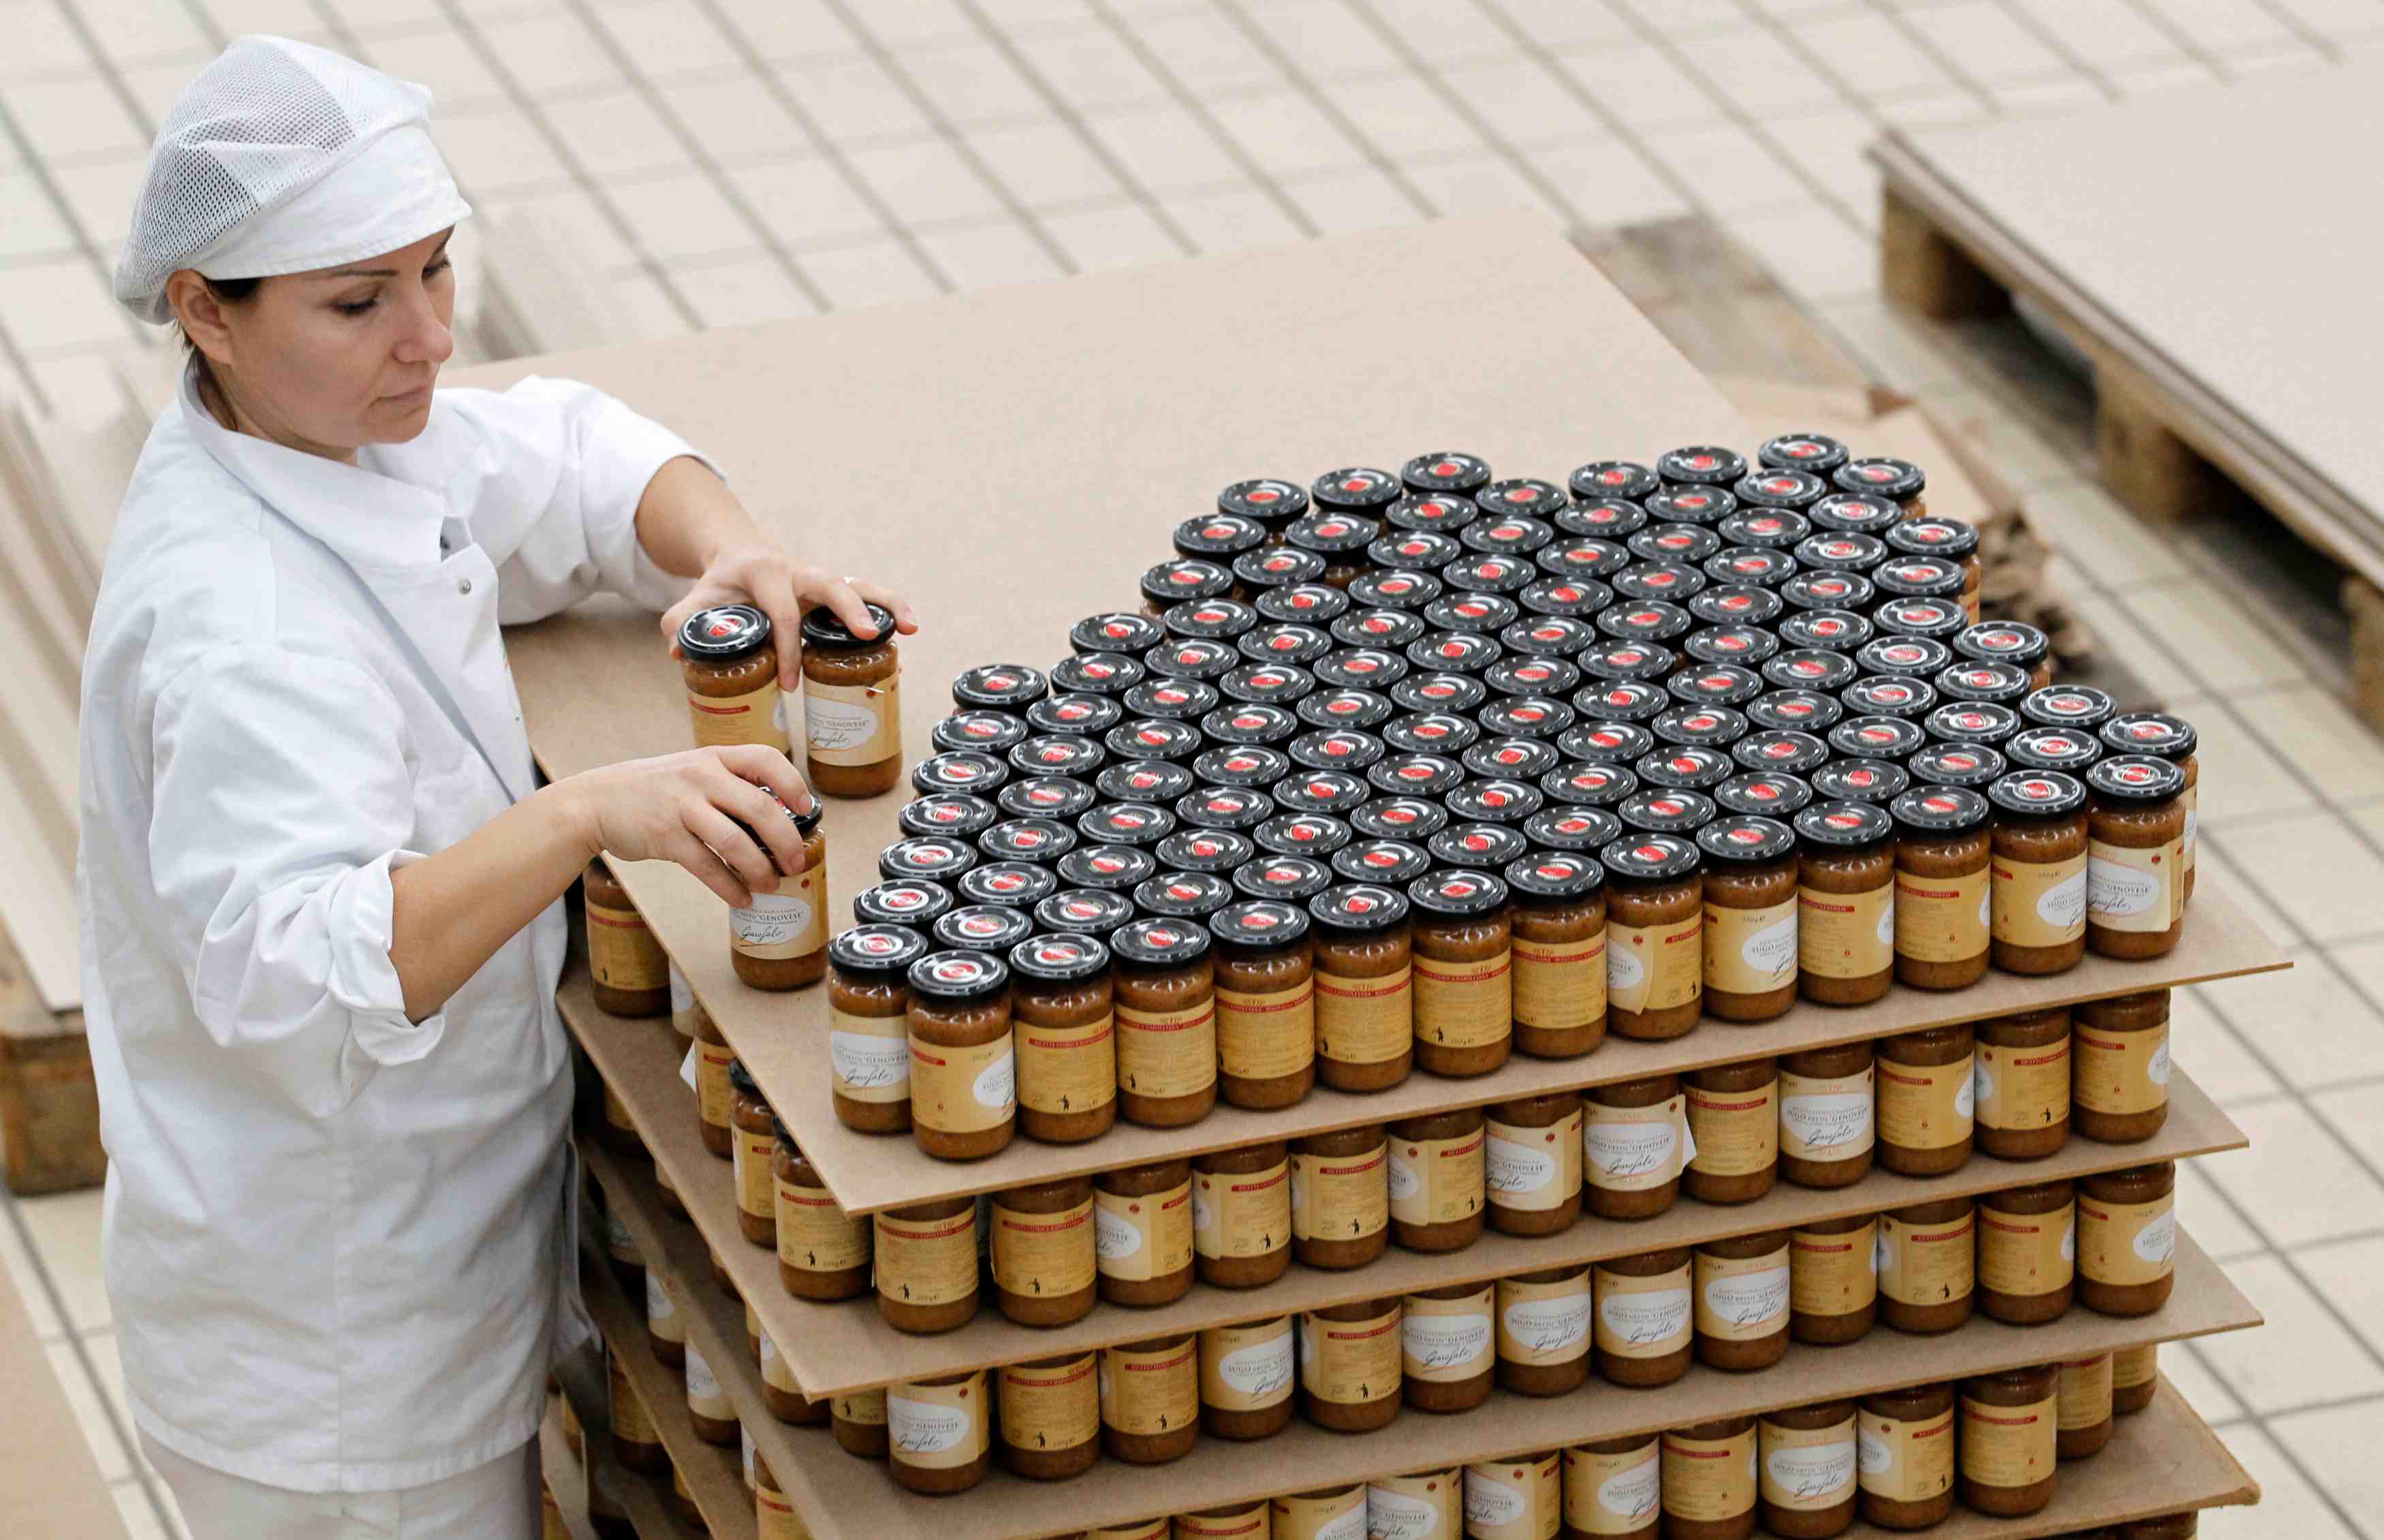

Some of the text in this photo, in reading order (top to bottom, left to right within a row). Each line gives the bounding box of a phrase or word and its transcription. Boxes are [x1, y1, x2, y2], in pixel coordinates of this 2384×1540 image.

[740, 925, 786, 943] Garofalo
[845, 1068, 894, 1085] Garofalo
[1805, 1125, 1854, 1146] Garofalo
[1605, 1154, 1657, 1175] Garofalo
[1733, 1300, 1780, 1327] Garofalo
[1533, 1326, 1580, 1351] Garofalo
[1627, 1320, 1676, 1345] Garofalo
[1423, 1347, 1473, 1366] Garofalo
[898, 1433, 944, 1450] Garofalo
[1793, 1474, 1842, 1498] Garofalo
